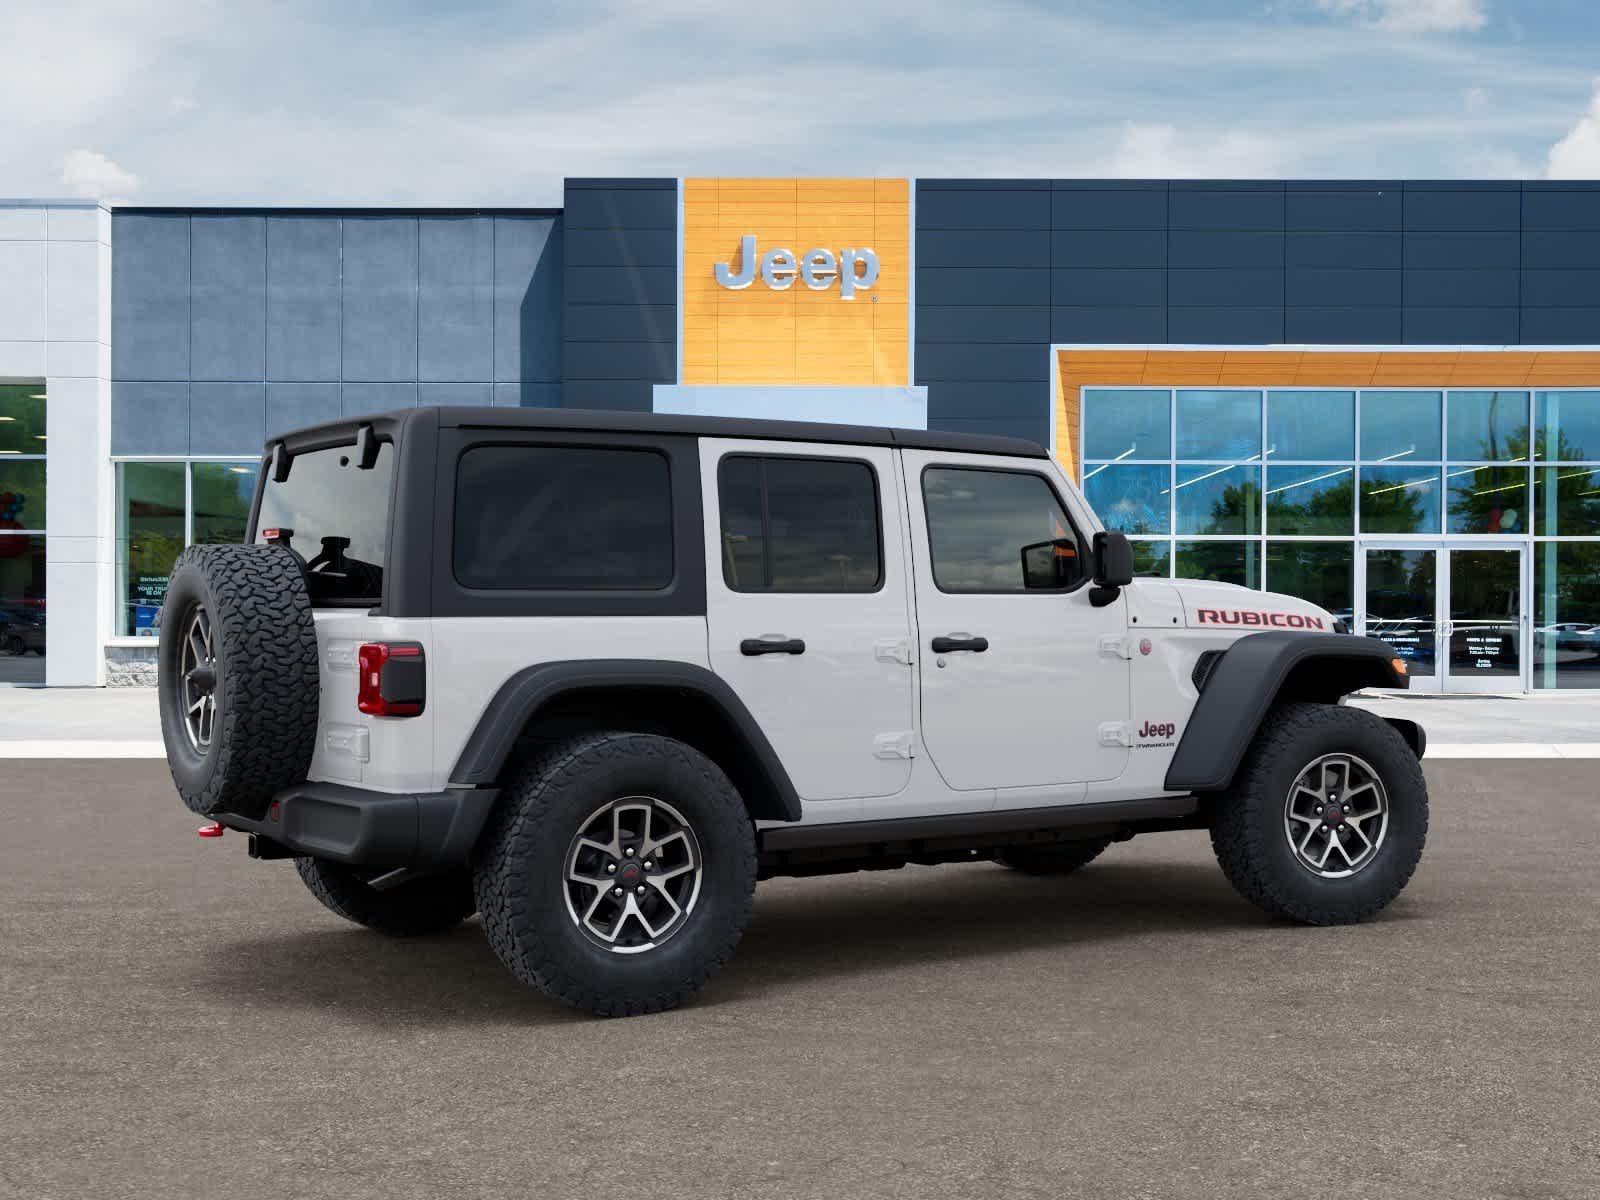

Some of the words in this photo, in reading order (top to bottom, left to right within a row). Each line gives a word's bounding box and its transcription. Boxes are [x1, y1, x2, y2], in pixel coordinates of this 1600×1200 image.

[713, 234, 880, 300] Jeep
[1197, 608, 1324, 630] RUBICON
[1139, 720, 1175, 739] Jeep
